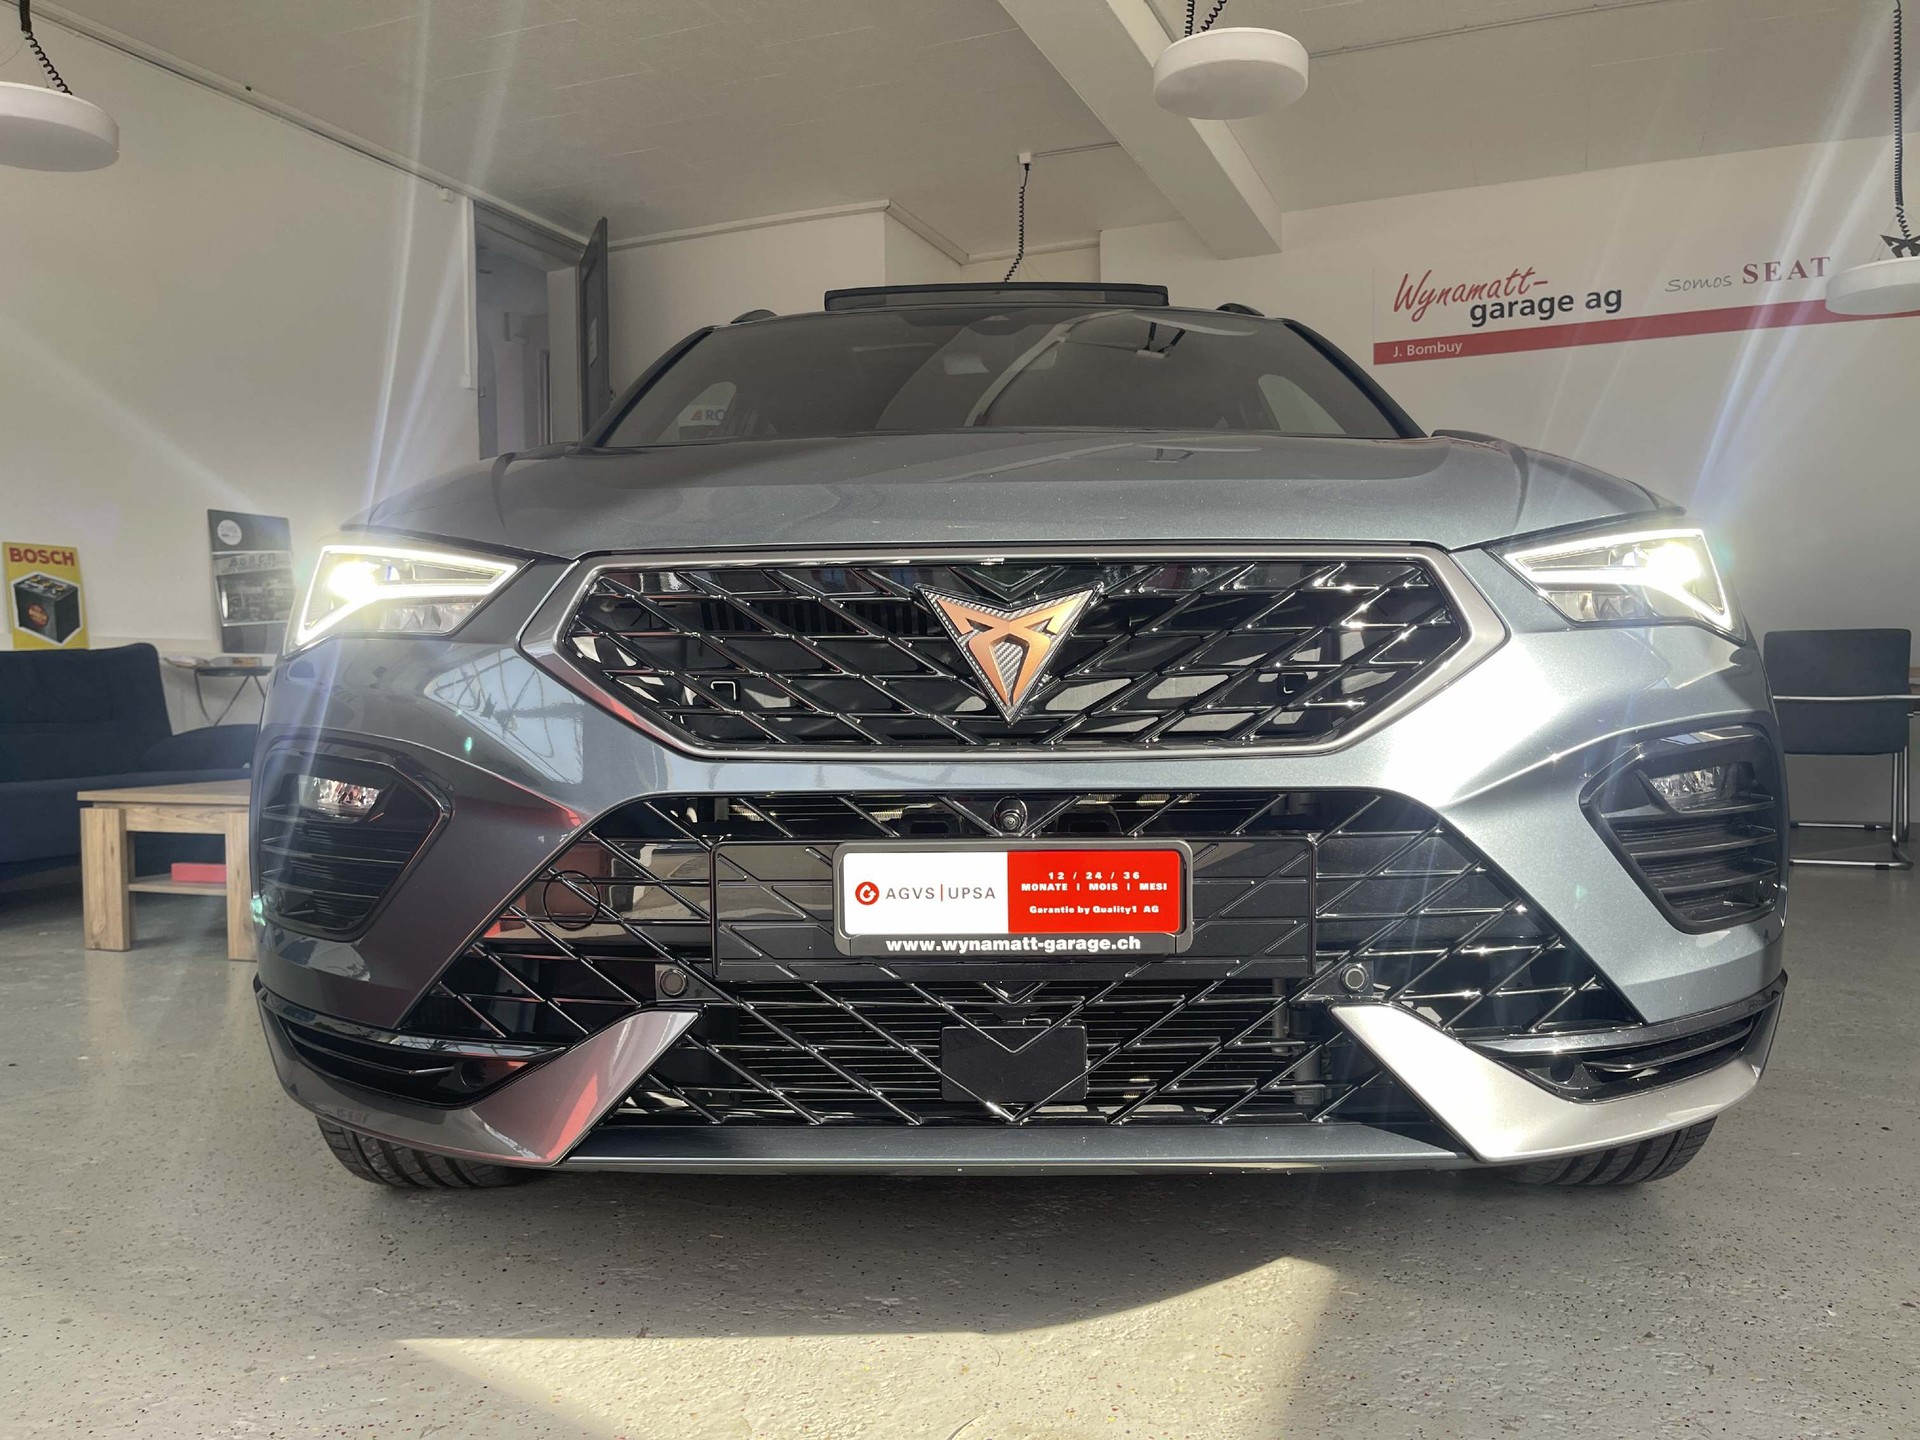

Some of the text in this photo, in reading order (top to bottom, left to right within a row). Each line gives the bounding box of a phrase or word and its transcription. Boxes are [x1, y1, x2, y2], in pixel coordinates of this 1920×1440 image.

[1664, 256, 1831, 293] Somos SEAT
[1393, 266, 1549, 323] Wynamatt-
[1469, 288, 1623, 328] garage ag
[1392, 341, 1463, 358] J. Bombuy
[9, 547, 75, 567] BOSCH
[1048, 871, 1065, 880] 12
[1085, 871, 1103, 880] 24
[1123, 871, 1141, 880] 36
[885, 887, 996, 900] AGVS UPSA
[1021, 883, 1068, 892] MONATE
[1088, 883, 1118, 891] MOIS
[1139, 883, 1168, 891] MESI
[1029, 905, 1160, 915] Garantie by Quality1 AG
[885, 935, 1141, 954] www.wynamatt-garage.ch
